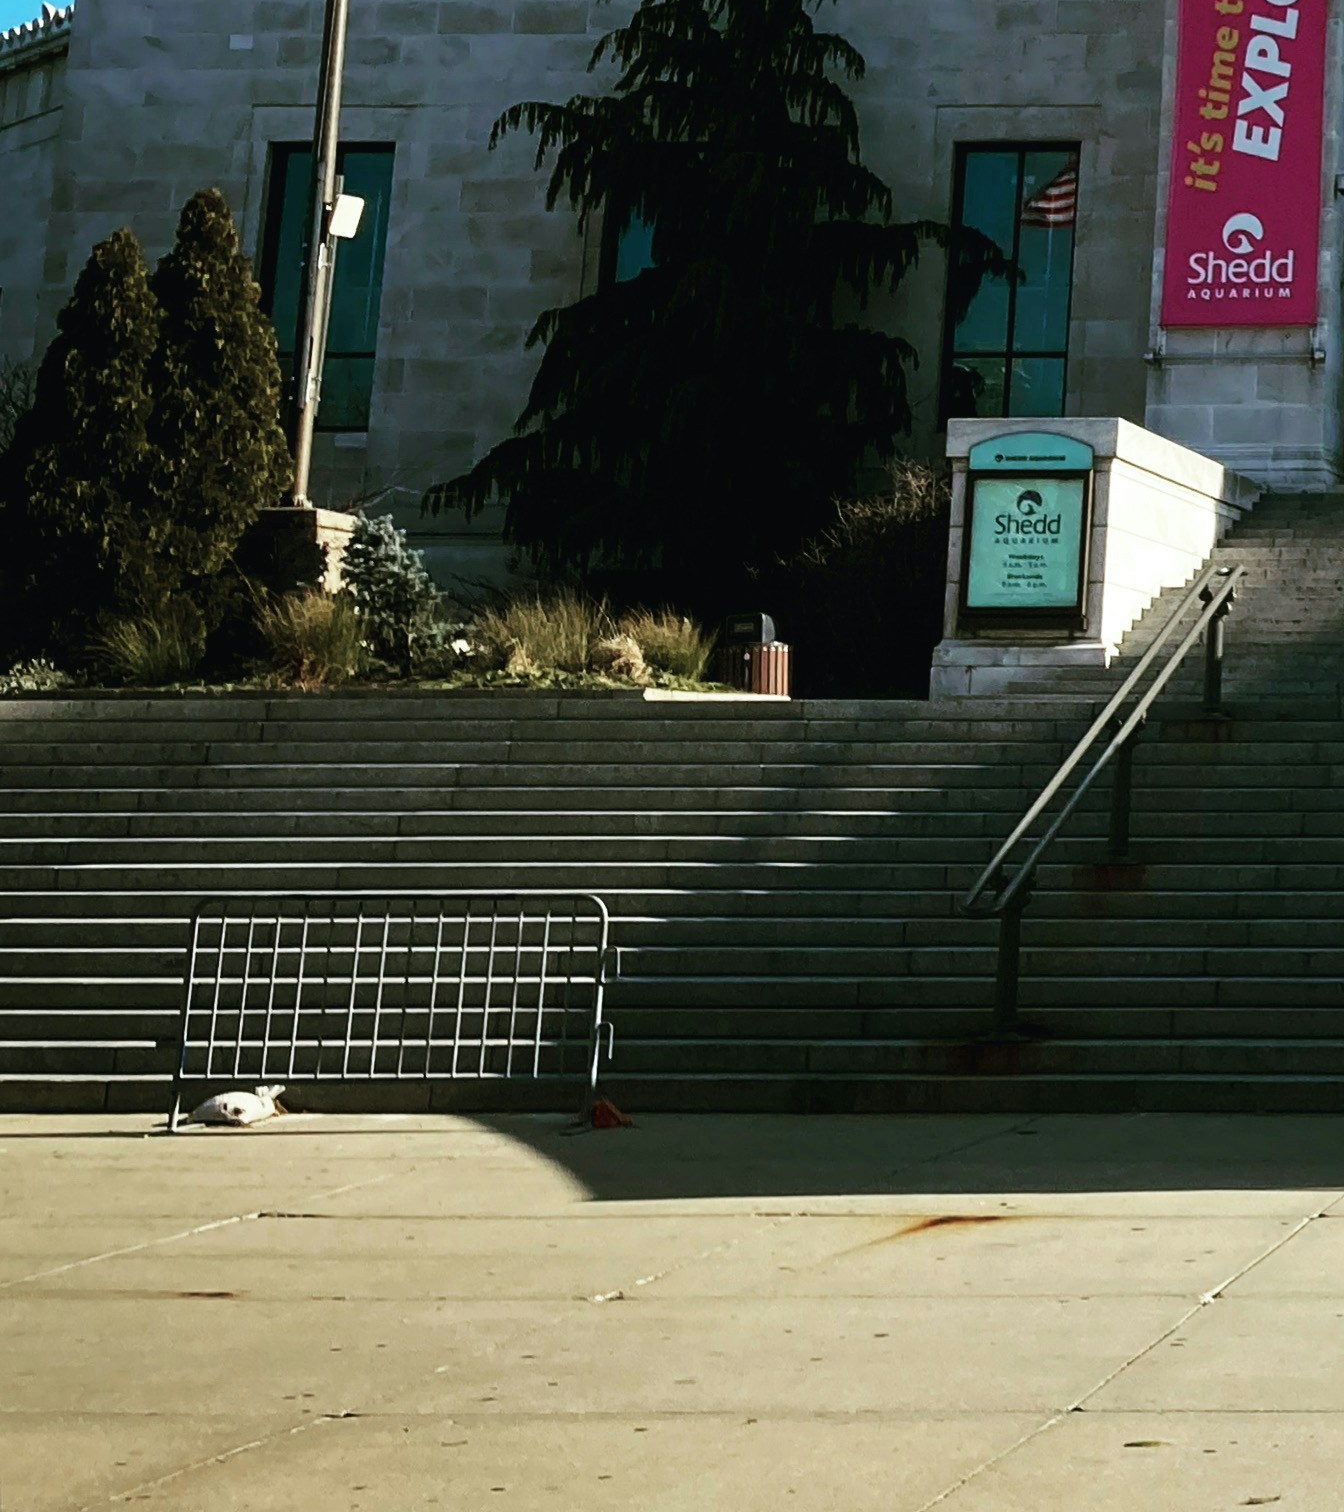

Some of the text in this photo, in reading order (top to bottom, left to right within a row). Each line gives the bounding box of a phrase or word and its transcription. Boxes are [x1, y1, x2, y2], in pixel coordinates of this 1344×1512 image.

[1199, 23, 1240, 121] time
[1184, 125, 1224, 193] it's
[1187, 249, 1294, 286] Shedd
[1187, 288, 1292, 300] AQUARIUM
[994, 514, 1061, 535] Shedd
[994, 537, 1059, 545] AQUARIUM
